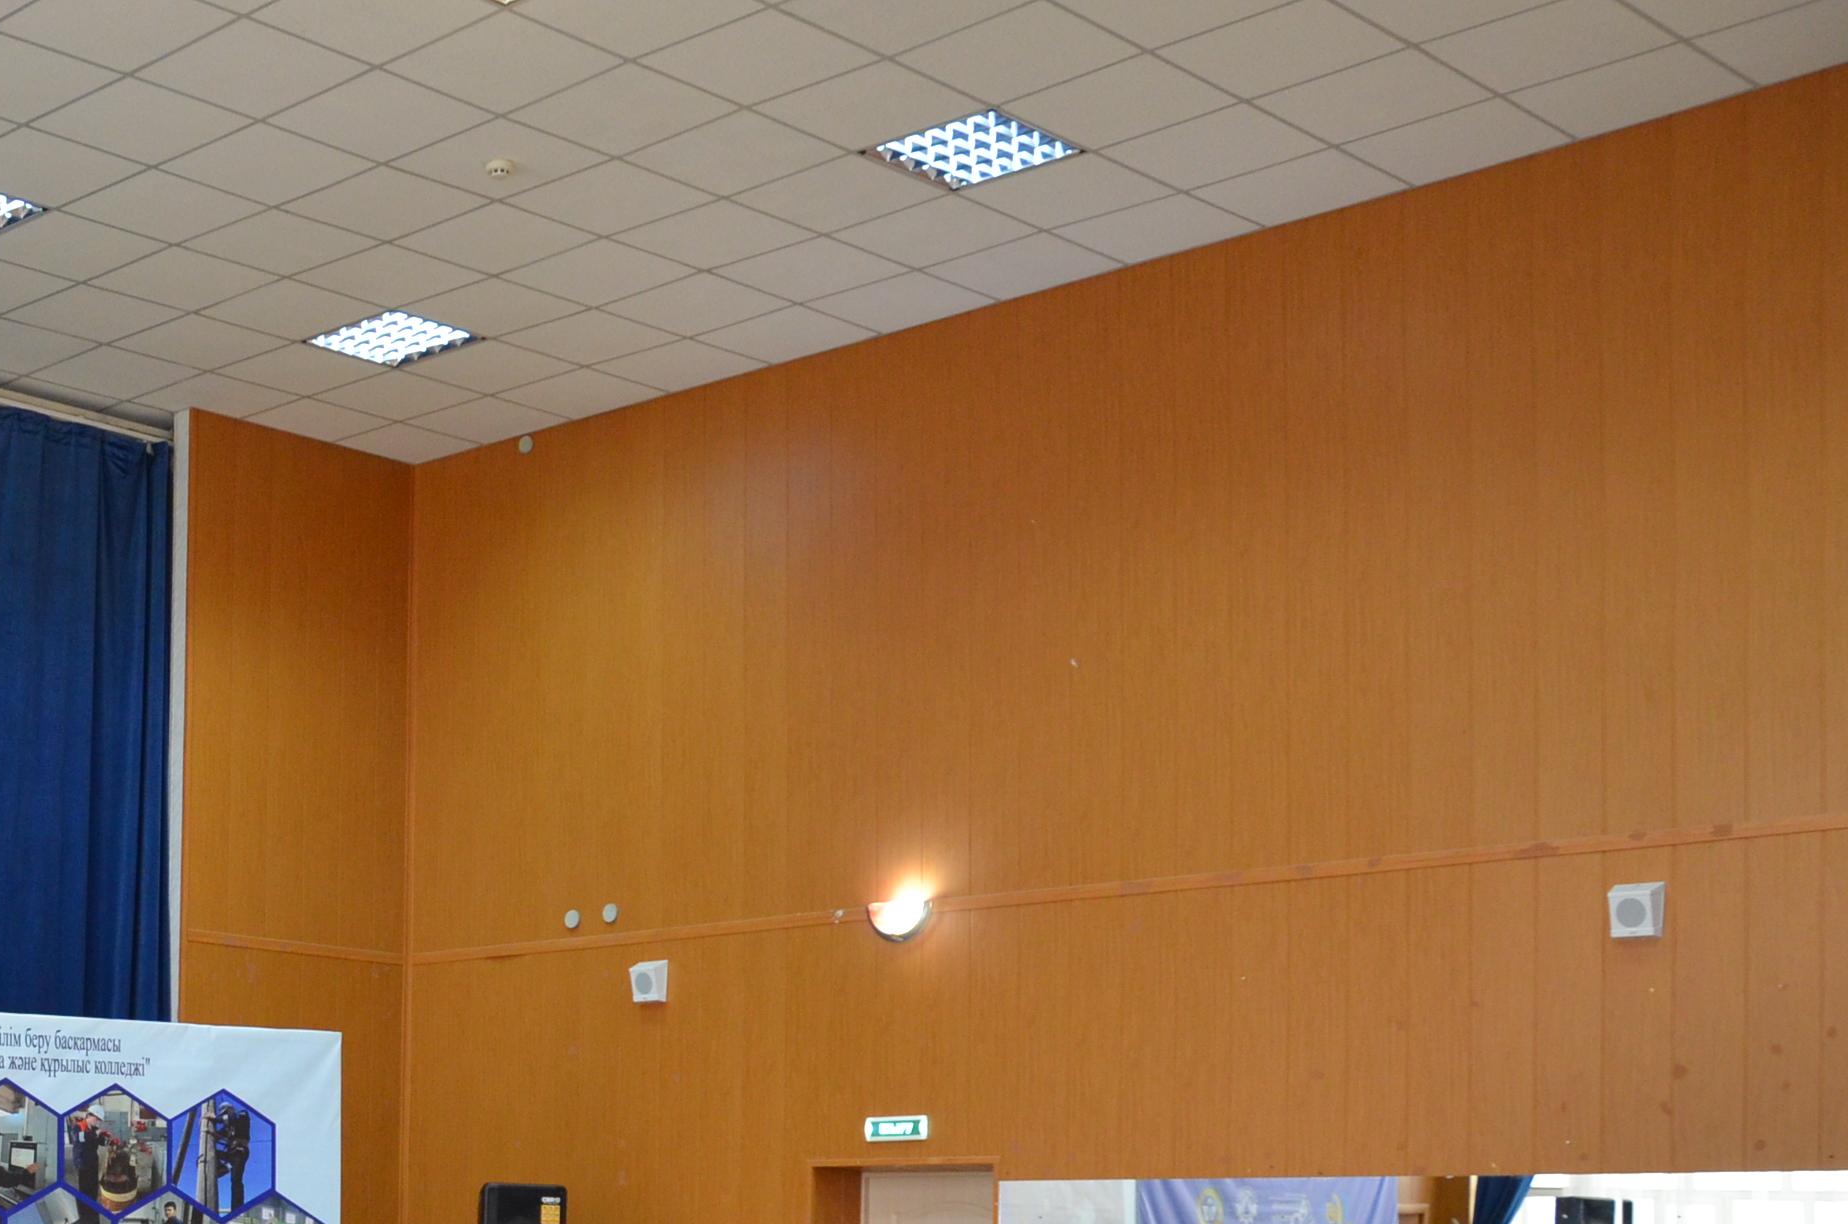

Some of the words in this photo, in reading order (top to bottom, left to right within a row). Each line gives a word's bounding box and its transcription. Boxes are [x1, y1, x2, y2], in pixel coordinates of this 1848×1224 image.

[24, 1028, 51, 1054] беру
[8, 1055, 37, 1071] және
[94, 1056, 150, 1078] колледжі"
